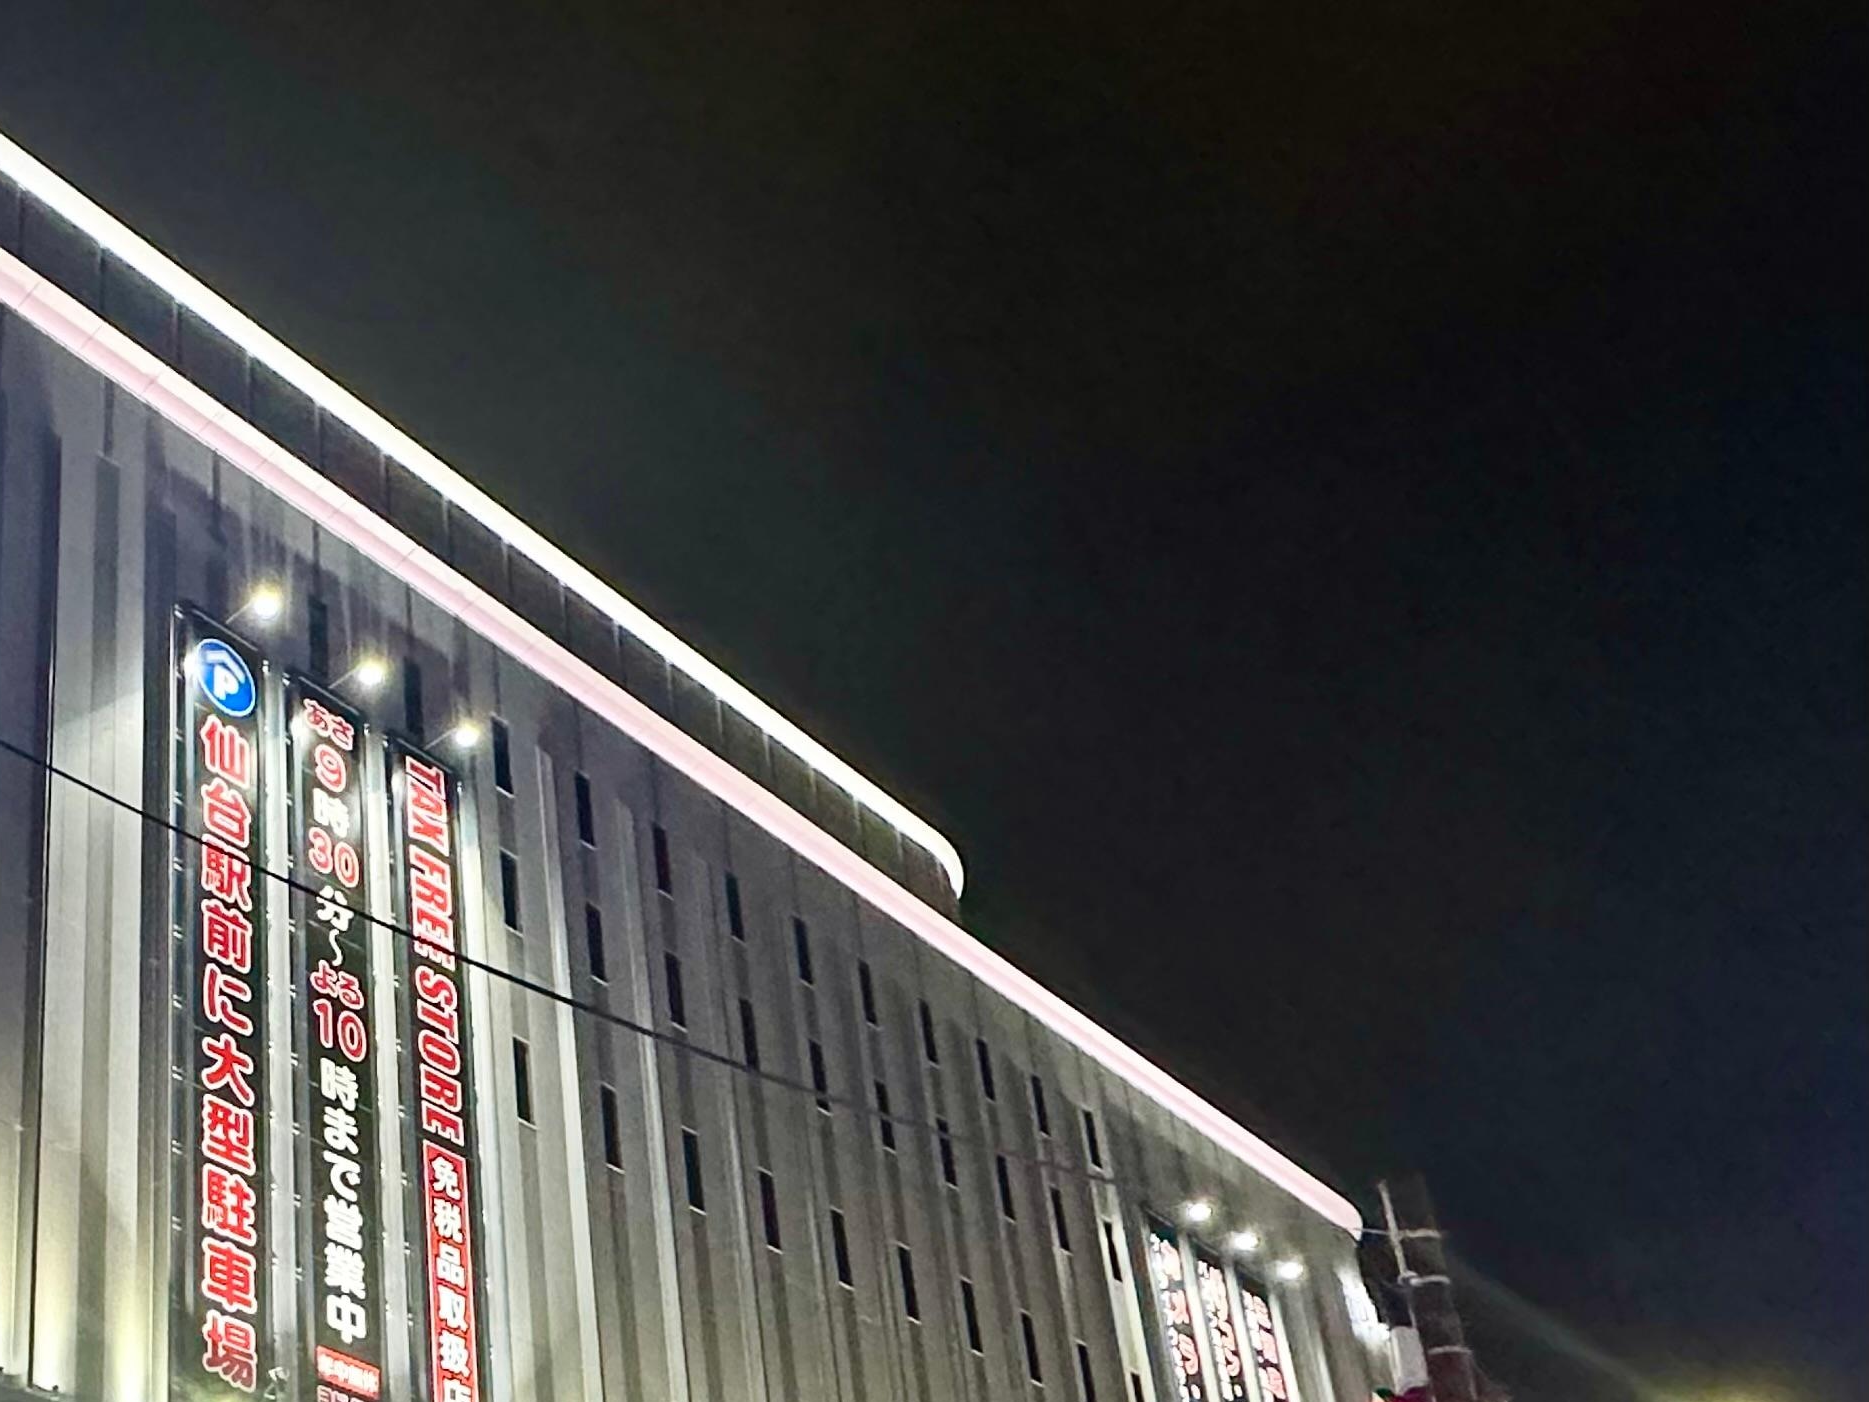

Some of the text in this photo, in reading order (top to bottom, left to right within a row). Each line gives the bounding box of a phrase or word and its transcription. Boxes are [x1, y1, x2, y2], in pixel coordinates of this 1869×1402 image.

[200, 714, 257, 1393] 仙台駅前に大型駐車場
[405, 755, 464, 1147] TAX FREE STORE
